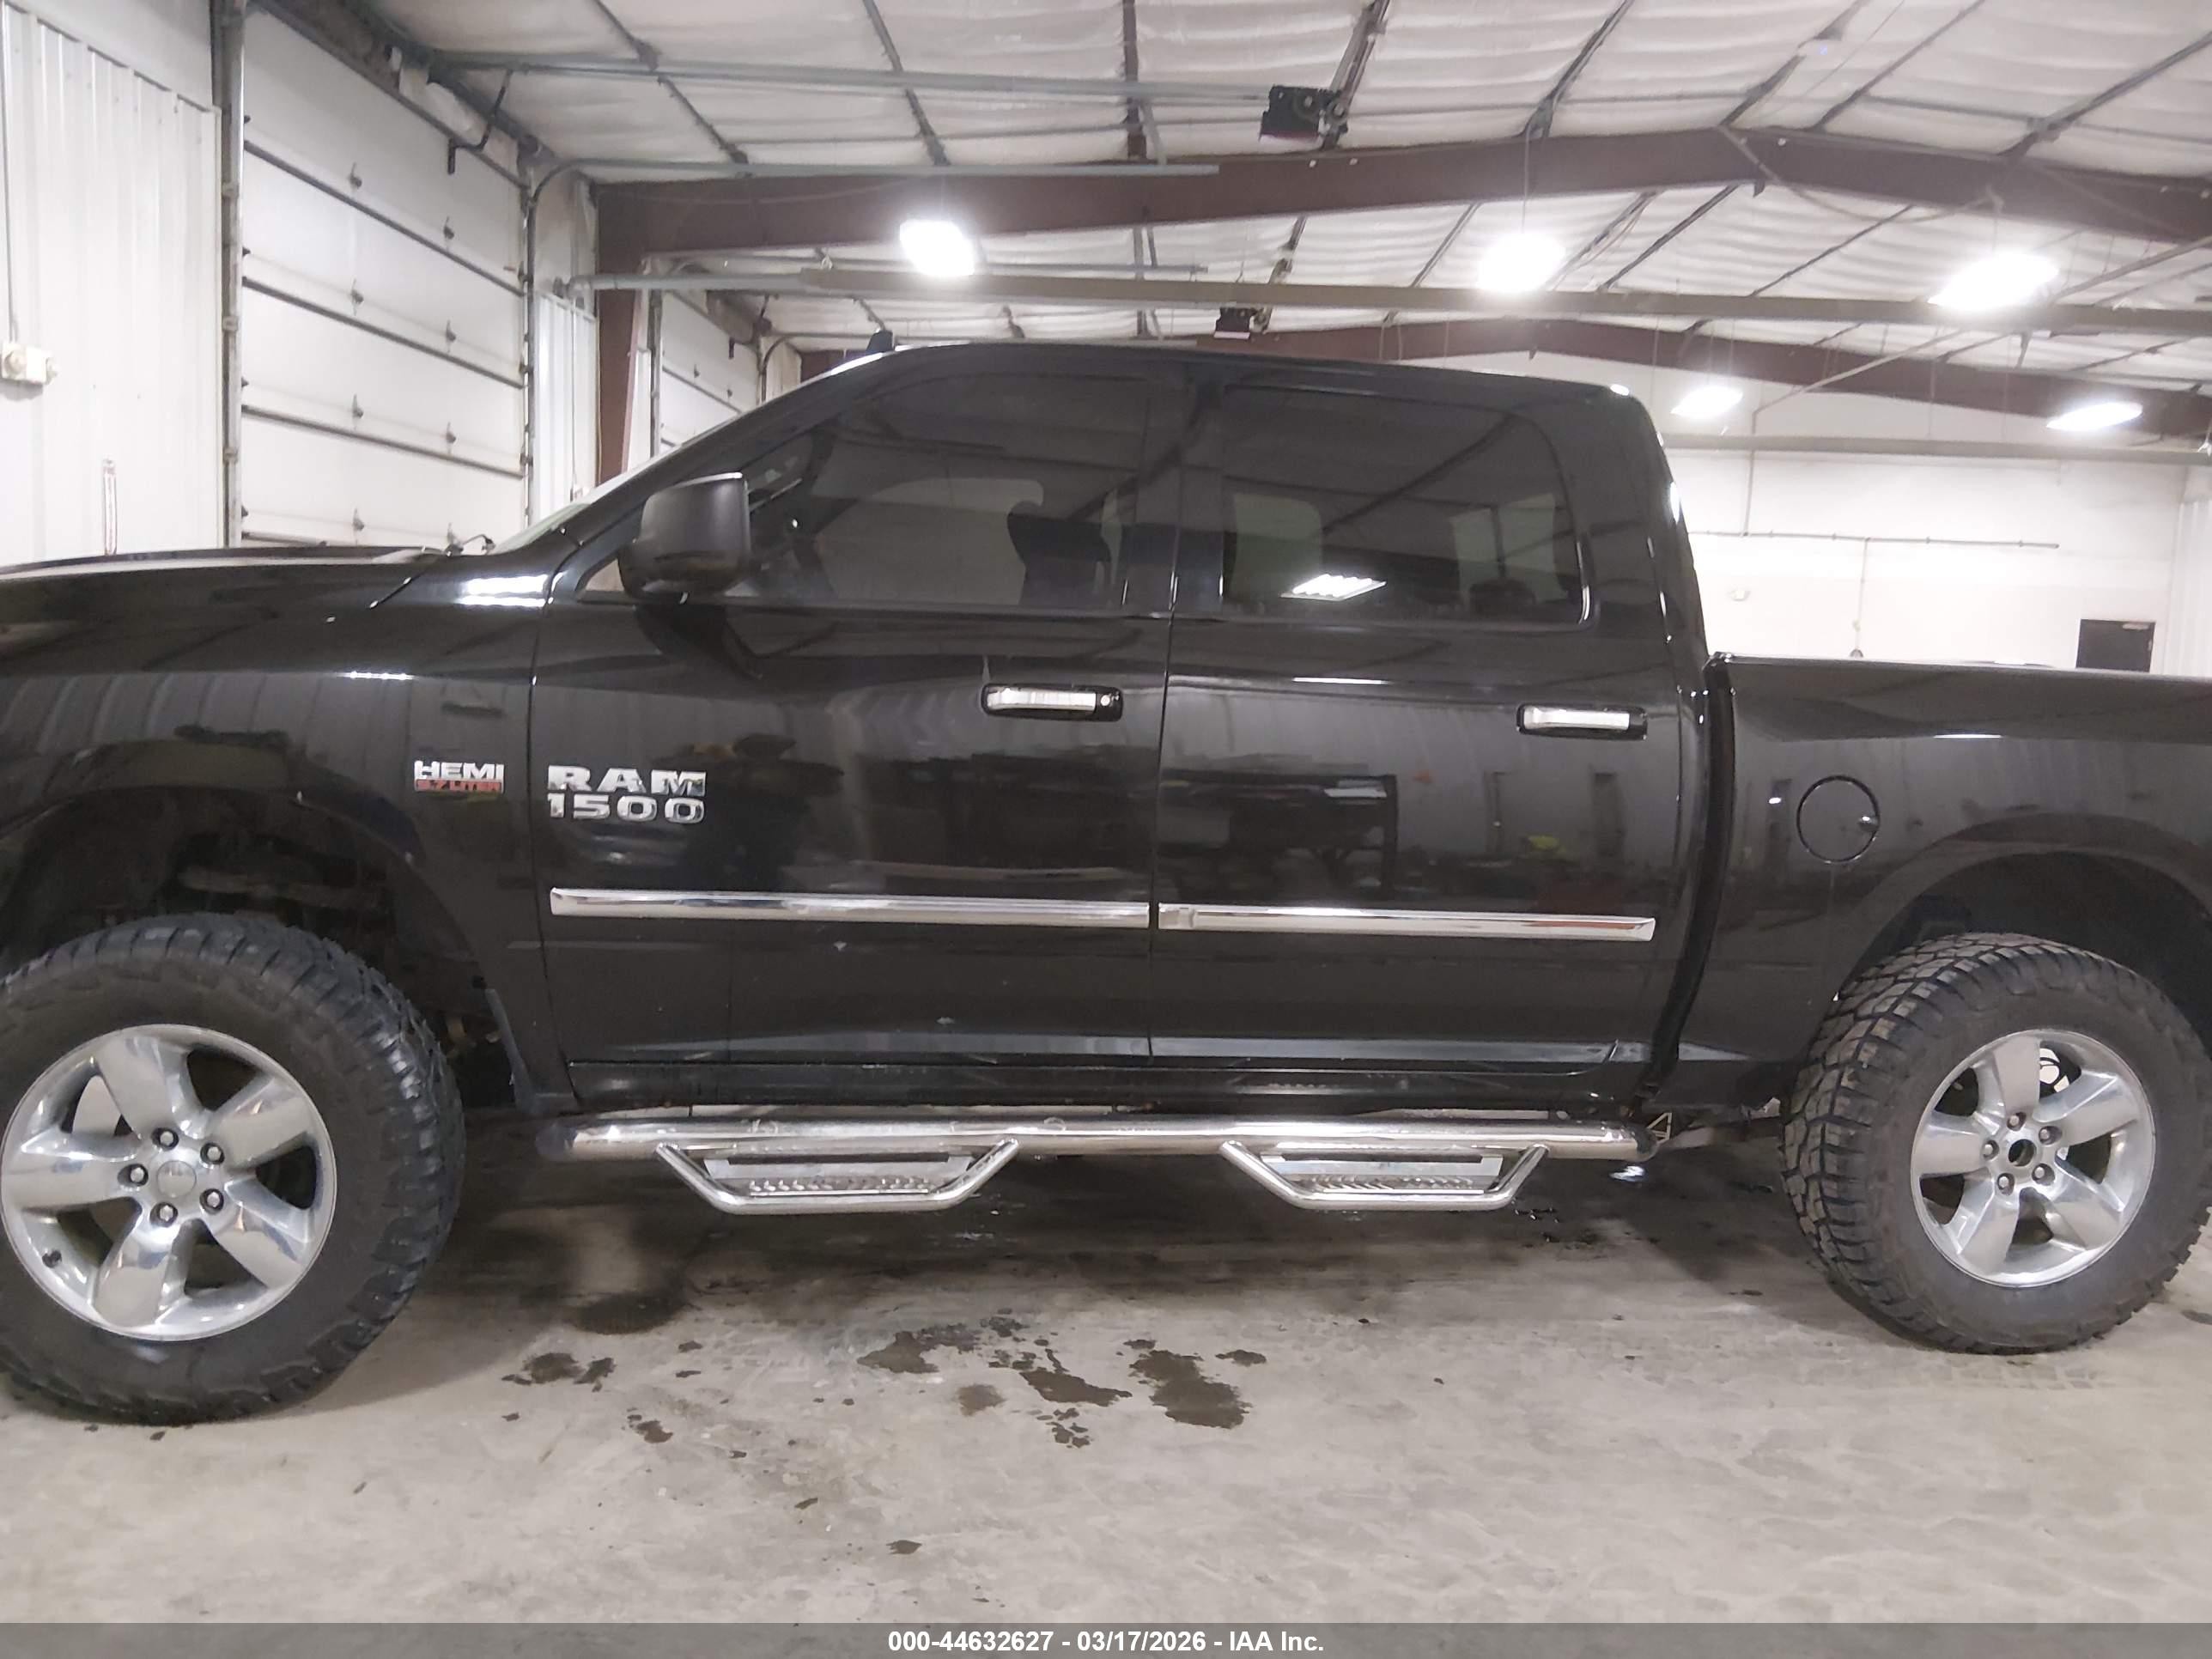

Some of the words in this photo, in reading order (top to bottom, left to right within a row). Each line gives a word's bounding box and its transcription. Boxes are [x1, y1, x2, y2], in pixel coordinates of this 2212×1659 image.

[414, 761, 504, 781] HEMI
[547, 765, 707, 797] RAM
[547, 793, 706, 824] 1500
